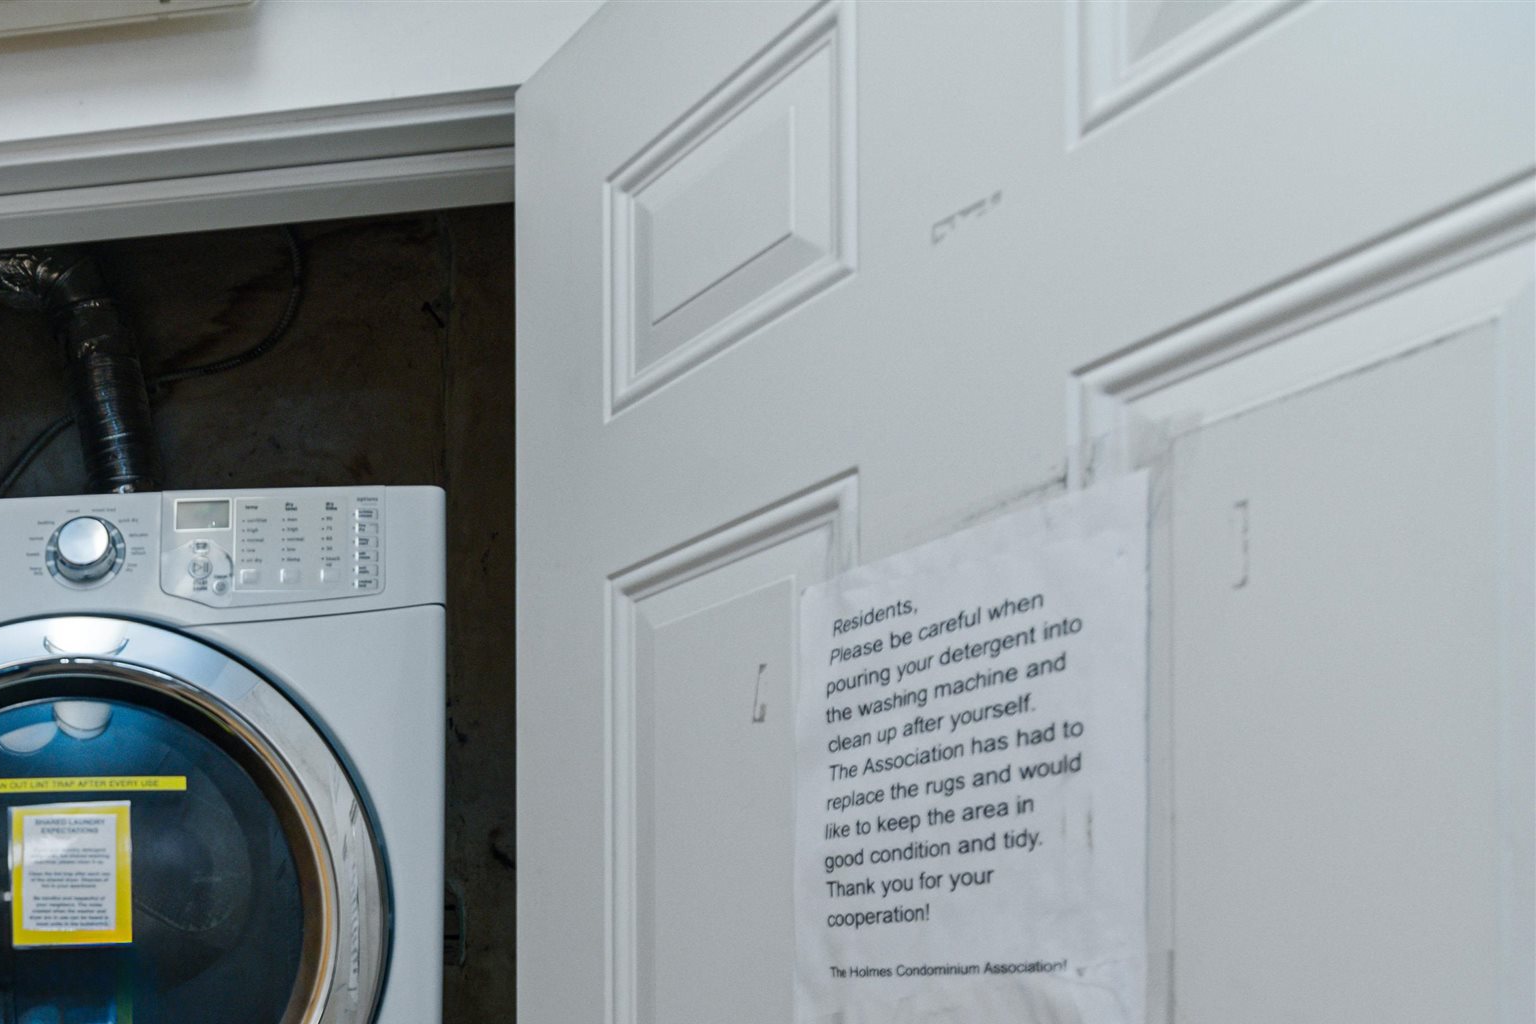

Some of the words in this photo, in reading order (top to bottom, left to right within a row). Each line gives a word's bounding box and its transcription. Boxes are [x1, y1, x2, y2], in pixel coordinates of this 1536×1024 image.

[830, 639, 883, 665] Please
[891, 631, 912, 649] be
[919, 608, 981, 642] careful
[988, 594, 1044, 621] when
[833, 599, 918, 636] Residents,
[826, 666, 890, 697] pouring
[897, 655, 933, 680] your
[940, 628, 1036, 666] detergent
[1044, 616, 1083, 641] into
[826, 705, 852, 723] the
[858, 688, 927, 717] washing
[935, 666, 1018, 698] machine
[1027, 653, 1066, 678] and
[828, 732, 871, 753] clean
[878, 727, 897, 746] up
[903, 715, 943, 737] after
[951, 696, 1036, 730] yourself.
[830, 763, 857, 781] The
[863, 743, 964, 775] Association
[971, 736, 1008, 755] has
[1017, 725, 1055, 747] had
[1063, 720, 1084, 739] to
[10, 782, 27, 790] OUT
[79, 780, 106, 788] AFTER
[141, 779, 160, 787] USE
[827, 787, 884, 811] replace
[891, 782, 918, 799] the
[926, 777, 965, 796] rugs
[973, 765, 1010, 786] and
[1019, 753, 1082, 779] would
[825, 823, 850, 840] like
[856, 819, 871, 836] to
[877, 813, 920, 834] keep
[928, 809, 955, 826] the
[962, 804, 1008, 821] area
[1017, 797, 1034, 815] in
[825, 852, 864, 873] good
[871, 843, 950, 864] condition
[958, 834, 996, 853] and
[1004, 830, 1043, 851] tidy.
[826, 879, 875, 898] Thank
[881, 873, 913, 896] you
[919, 872, 941, 890] for
[950, 868, 994, 891] your
[827, 904, 929, 929] cooperation!
[831, 966, 847, 978] The
[849, 965, 892, 977] Holmes
[897, 963, 980, 977] Condominium
